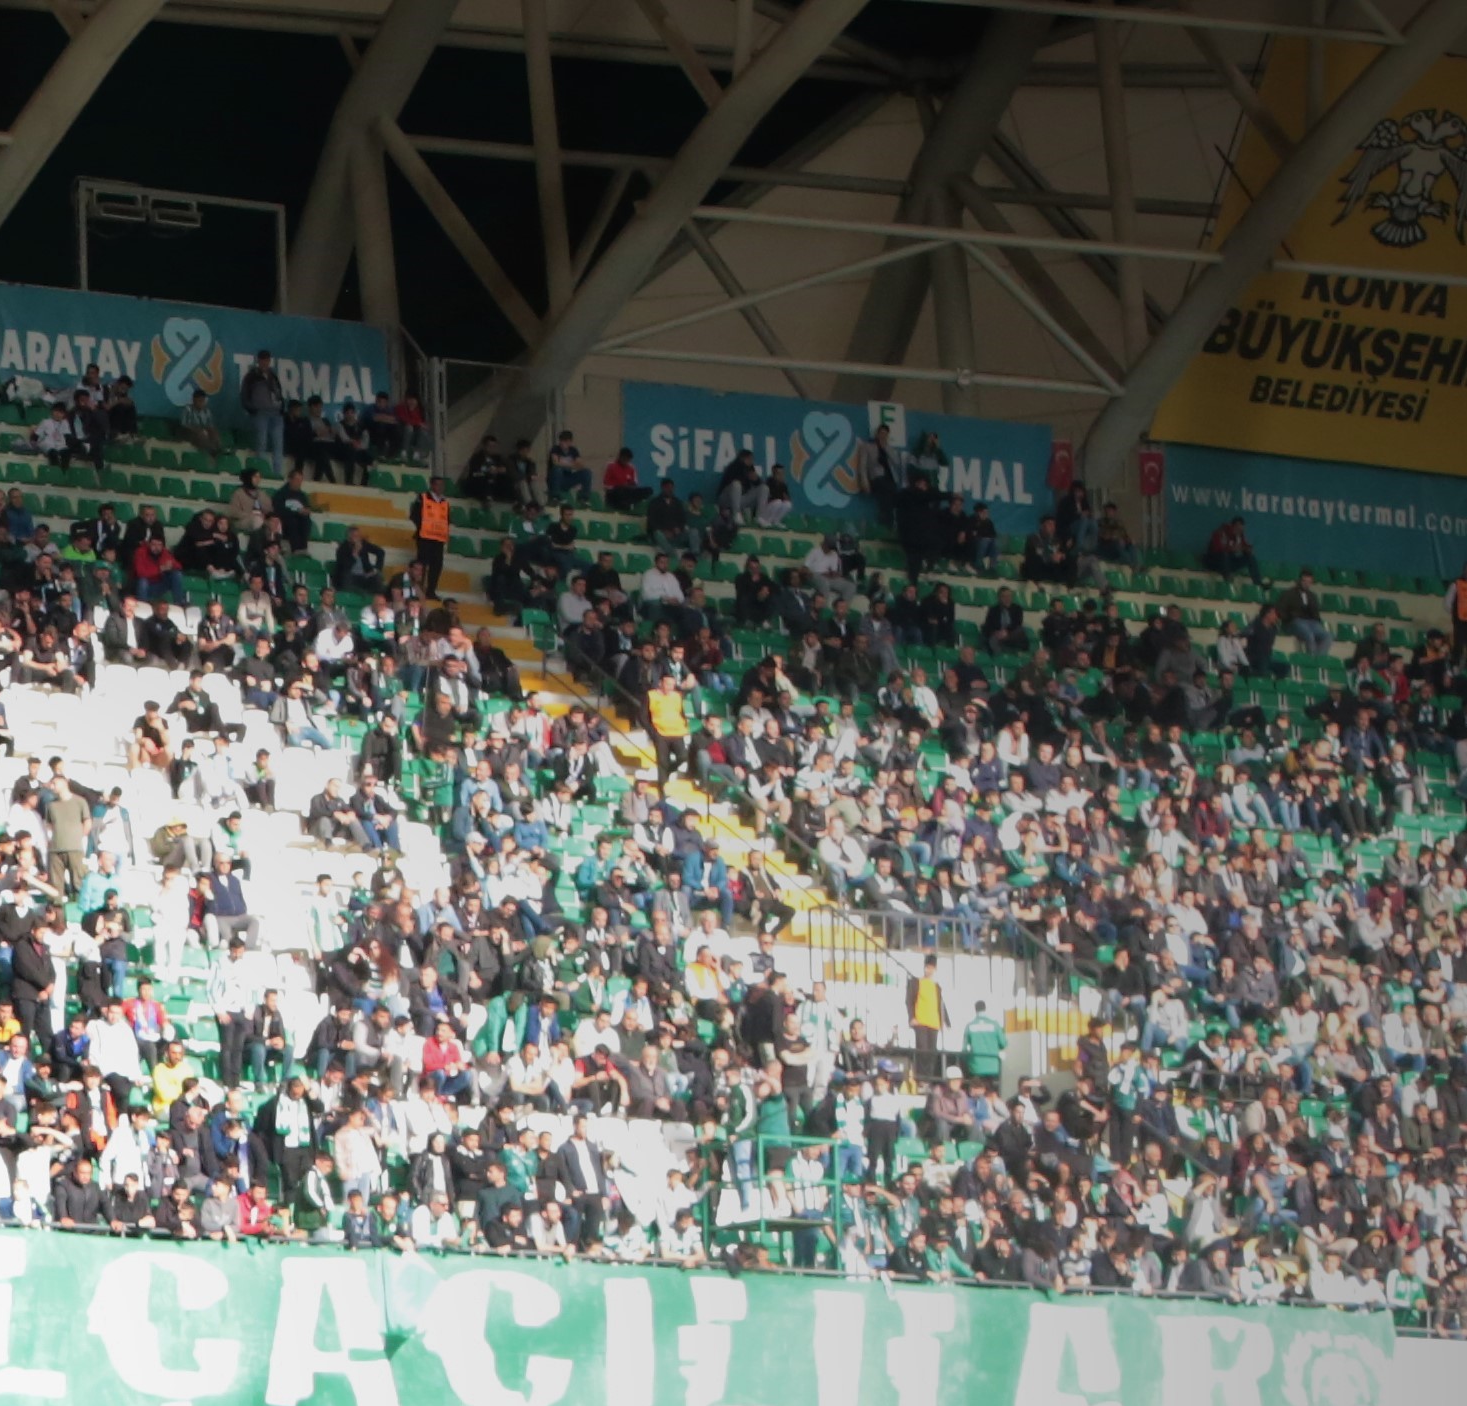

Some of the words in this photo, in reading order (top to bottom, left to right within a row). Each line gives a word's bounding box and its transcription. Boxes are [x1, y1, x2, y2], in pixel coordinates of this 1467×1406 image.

[1301, 274, 1448, 319] KONYA
[233, 353, 377, 405] TRMAL
[1248, 375, 1430, 423] BELEDİYESİ
[1171, 482, 1467, 537] www.karataytermal.com
